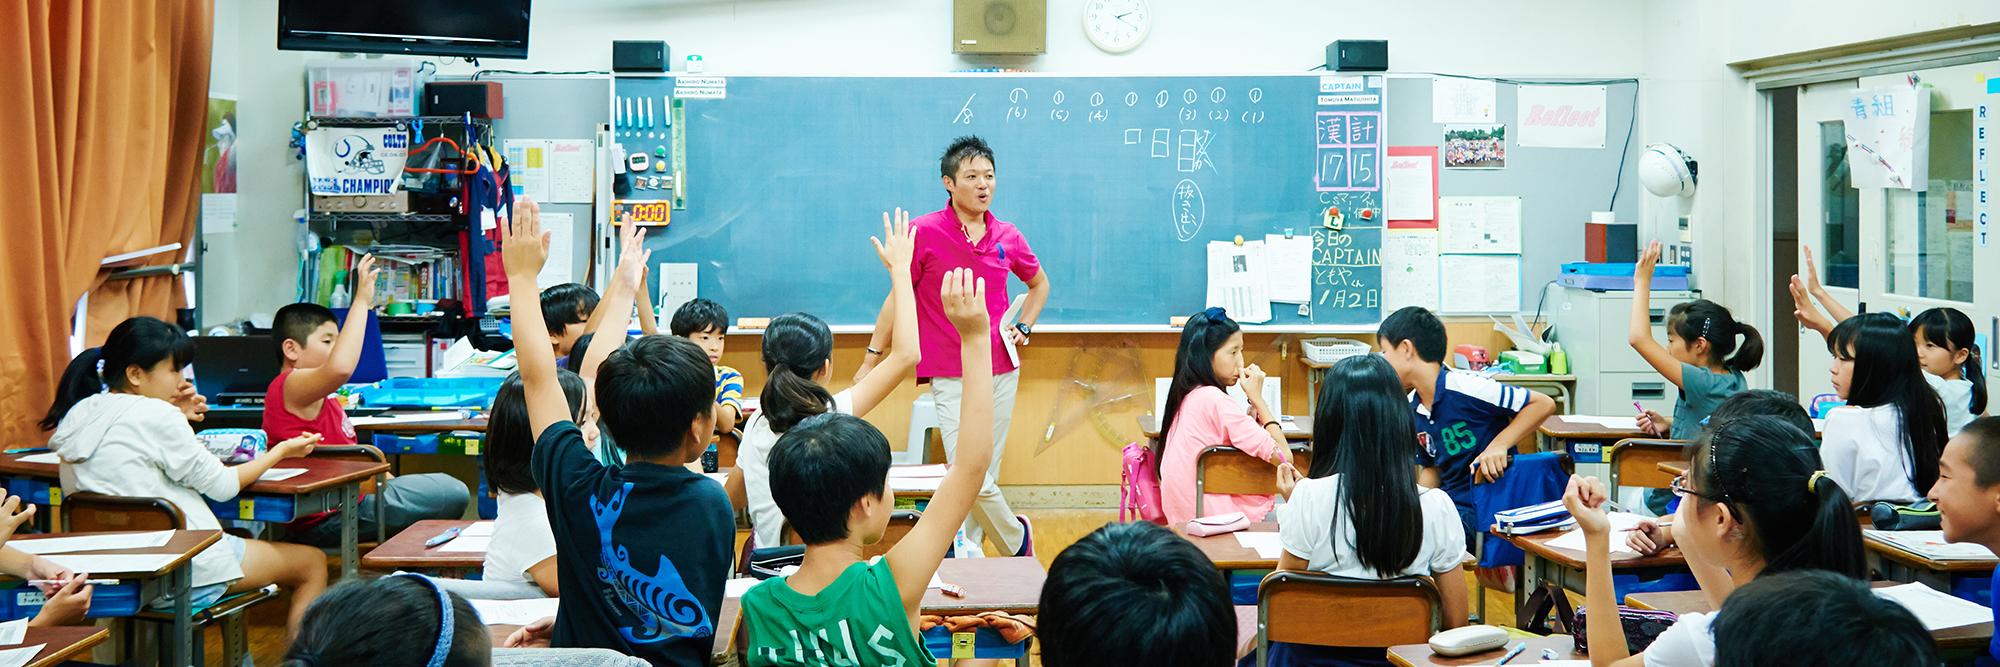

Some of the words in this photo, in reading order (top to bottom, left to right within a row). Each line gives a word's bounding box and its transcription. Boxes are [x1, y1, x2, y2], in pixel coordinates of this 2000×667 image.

[1321, 82, 1361, 91] CAPTAIN
[1318, 116, 1342, 144] 漢
[1351, 116, 1374, 142] 計
[383, 134, 407, 148] COLTS
[1321, 154, 1344, 182] 17
[1353, 153, 1372, 182] 15
[1978, 105, 1987, 245] REFLECT
[342, 178, 395, 194] CHAMPIO
[633, 204, 666, 222] 0:00
[1312, 230, 1352, 247] 今日の
[1311, 247, 1382, 265] CAPTAIN
[1441, 421, 1477, 456] 85
